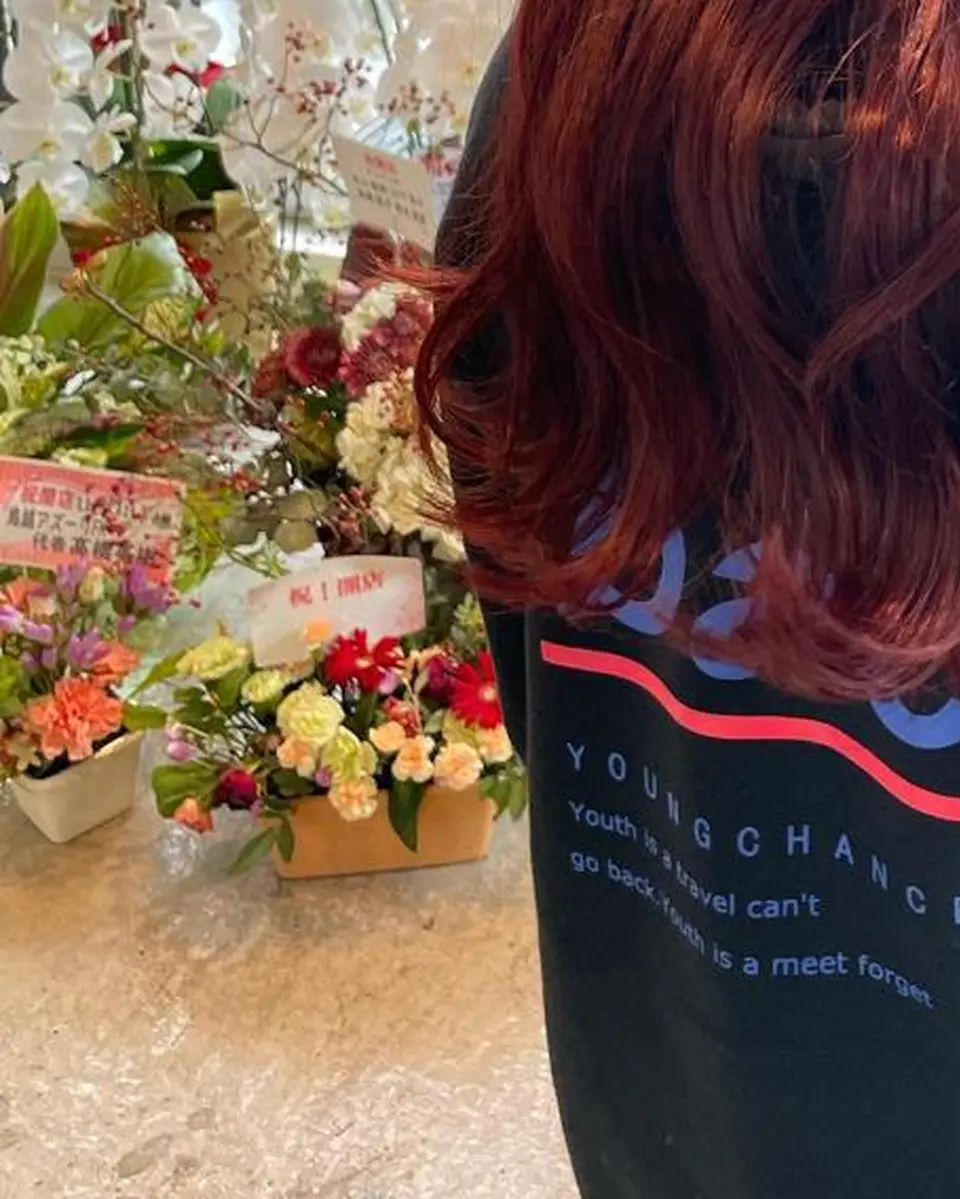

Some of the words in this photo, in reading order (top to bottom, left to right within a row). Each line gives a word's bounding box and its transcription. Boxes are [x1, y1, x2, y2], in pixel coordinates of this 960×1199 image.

[568, 800, 637, 841] Youth
[643, 828, 658, 856] is
[662, 849, 673, 871] a
[675, 861, 735, 916] travel
[746, 893, 821, 919] can't
[570, 851, 601, 873] go
[712, 942, 734, 970] is
[743, 957, 760, 976] a
[772, 951, 849, 977] meet
